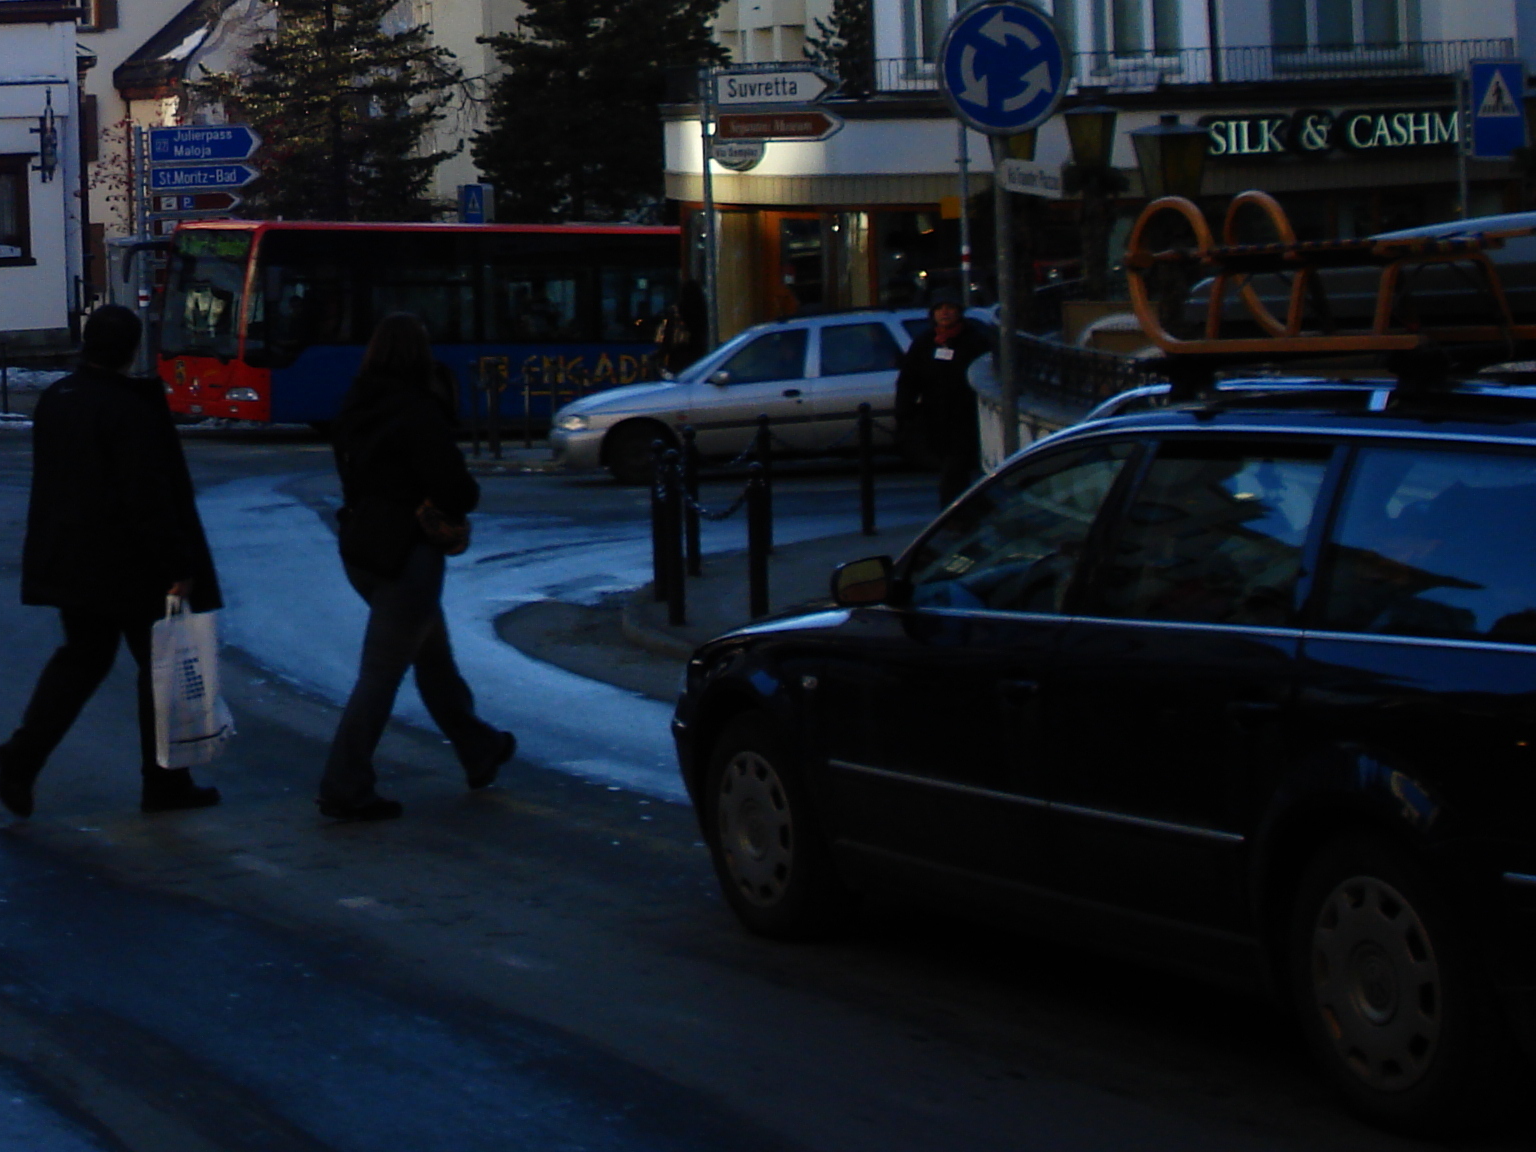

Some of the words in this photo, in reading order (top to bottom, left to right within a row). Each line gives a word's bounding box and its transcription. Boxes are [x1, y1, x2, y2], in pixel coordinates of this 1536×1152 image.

[727, 77, 798, 98] Suvretta
[173, 129, 233, 142] Julierpass
[1207, 118, 1286, 157] SILK
[1301, 114, 1334, 152] &
[1346, 110, 1467, 150] CASHM
[173, 145, 212, 158] Maloja
